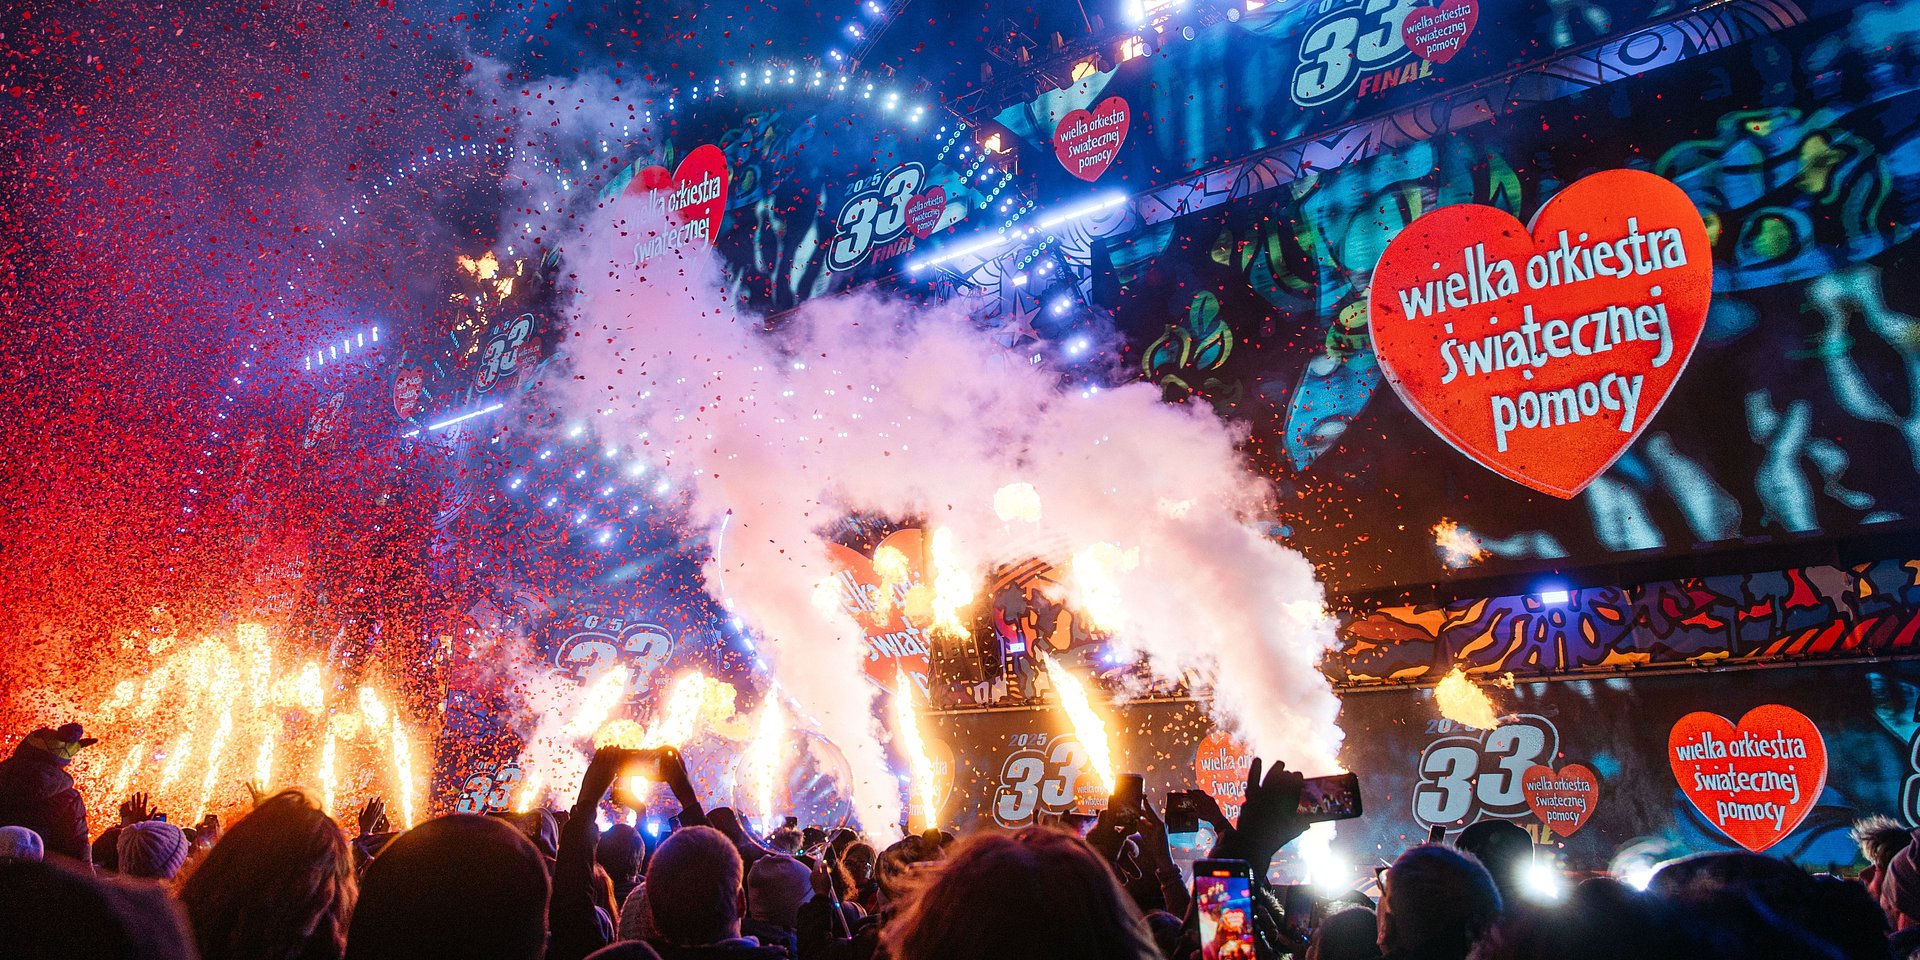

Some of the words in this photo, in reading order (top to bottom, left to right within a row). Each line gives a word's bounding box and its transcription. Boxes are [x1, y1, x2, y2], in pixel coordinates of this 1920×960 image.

[1406, 12, 1433, 35] wielka
[1434, 4, 1471, 24] orkiestra
[1415, 18, 1467, 46] świątecznej
[1296, 0, 1418, 100] 33
[1426, 36, 1460, 57] pomocy
[1357, 60, 1434, 97] FINAŁ
[1060, 119, 1088, 142] wielka
[1090, 109, 1124, 131] orkiestra
[1068, 126, 1120, 158] świątecznej
[1079, 149, 1112, 173] pomocy
[668, 171, 720, 213] orkiestra
[845, 171, 881, 196] 2025
[835, 168, 919, 263] 33
[1398, 243, 1519, 320] wielka
[1526, 216, 1688, 290] orkiestra
[1440, 285, 1674, 385] świątecznej
[477, 318, 531, 388] 33
[1491, 372, 1644, 453] pomocy
[575, 614, 624, 632] 2025
[1009, 733, 1048, 747] 2025
[1425, 718, 1476, 734] 202
[1201, 748, 1235, 770] wielka
[1675, 731, 1727, 761] wielka
[1729, 730, 1807, 759] orkiestra
[998, 741, 1088, 821] 33
[1417, 724, 1546, 824] 33
[1526, 777, 1553, 791] wielka
[1554, 776, 1590, 792] orkiestra
[1694, 763, 1800, 805] świątecznej
[1536, 792, 1586, 813] świątecznej
[1547, 810, 1580, 826] pomocy
[1717, 800, 1786, 831] pomocy
